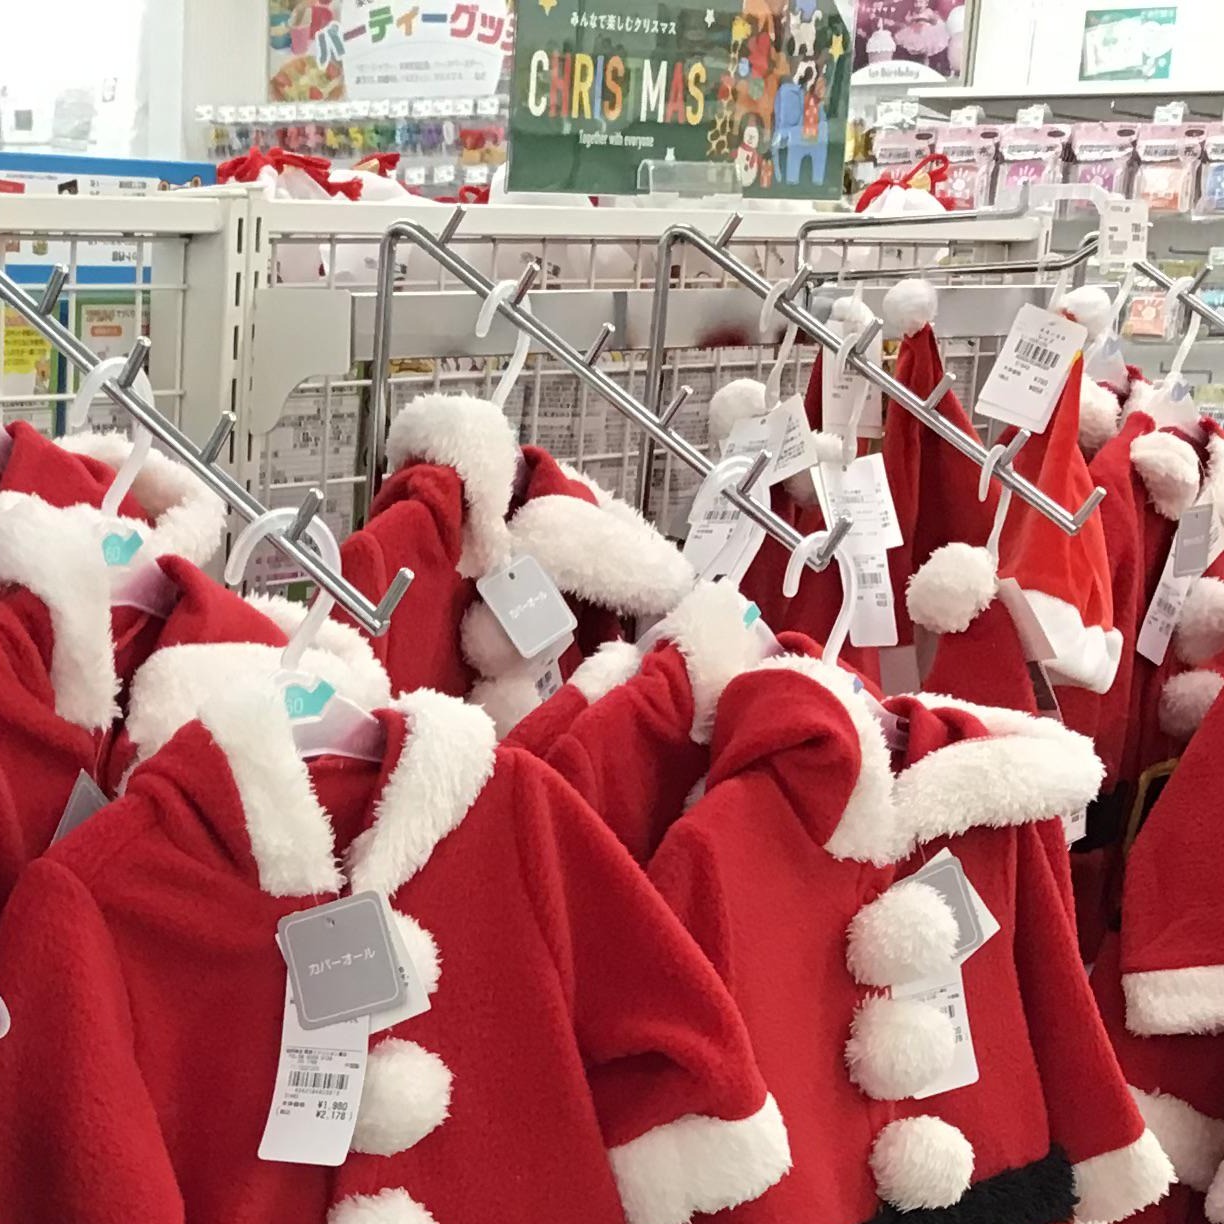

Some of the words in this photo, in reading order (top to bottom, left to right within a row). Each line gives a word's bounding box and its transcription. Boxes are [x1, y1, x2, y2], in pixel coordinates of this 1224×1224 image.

[571, 11, 677, 35] みんなで楽しむクリスマス
[528, 50, 706, 125] CHRISTMAS
[579, 129, 608, 148] Together
[609, 130, 624, 146] with
[624, 135, 655, 150] everyone
[308, 947, 376, 976] カバーオール
